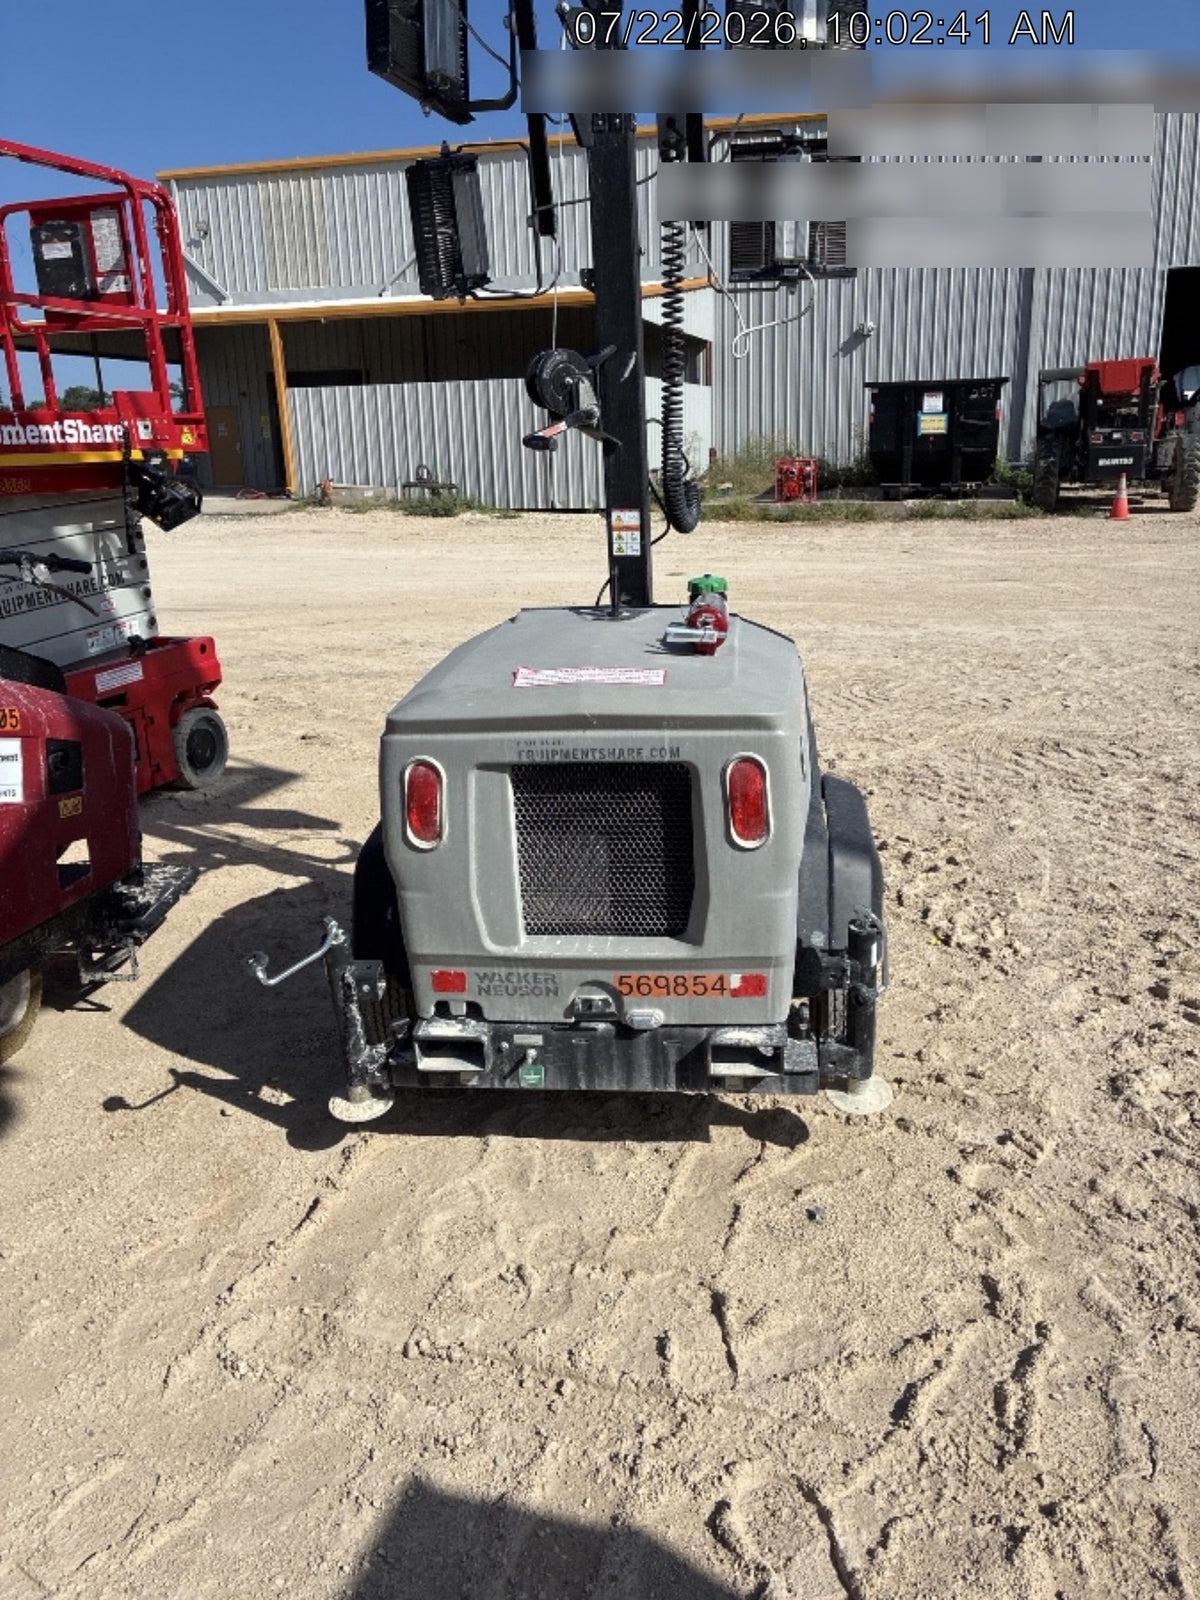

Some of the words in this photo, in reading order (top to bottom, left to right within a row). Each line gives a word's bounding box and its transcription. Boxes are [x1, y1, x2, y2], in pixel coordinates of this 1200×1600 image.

[0, 418, 124, 445] mentShare
[475, 972, 558, 984] WACKER
[617, 974, 728, 996] 569854
[477, 985, 559, 997] NEUSON
